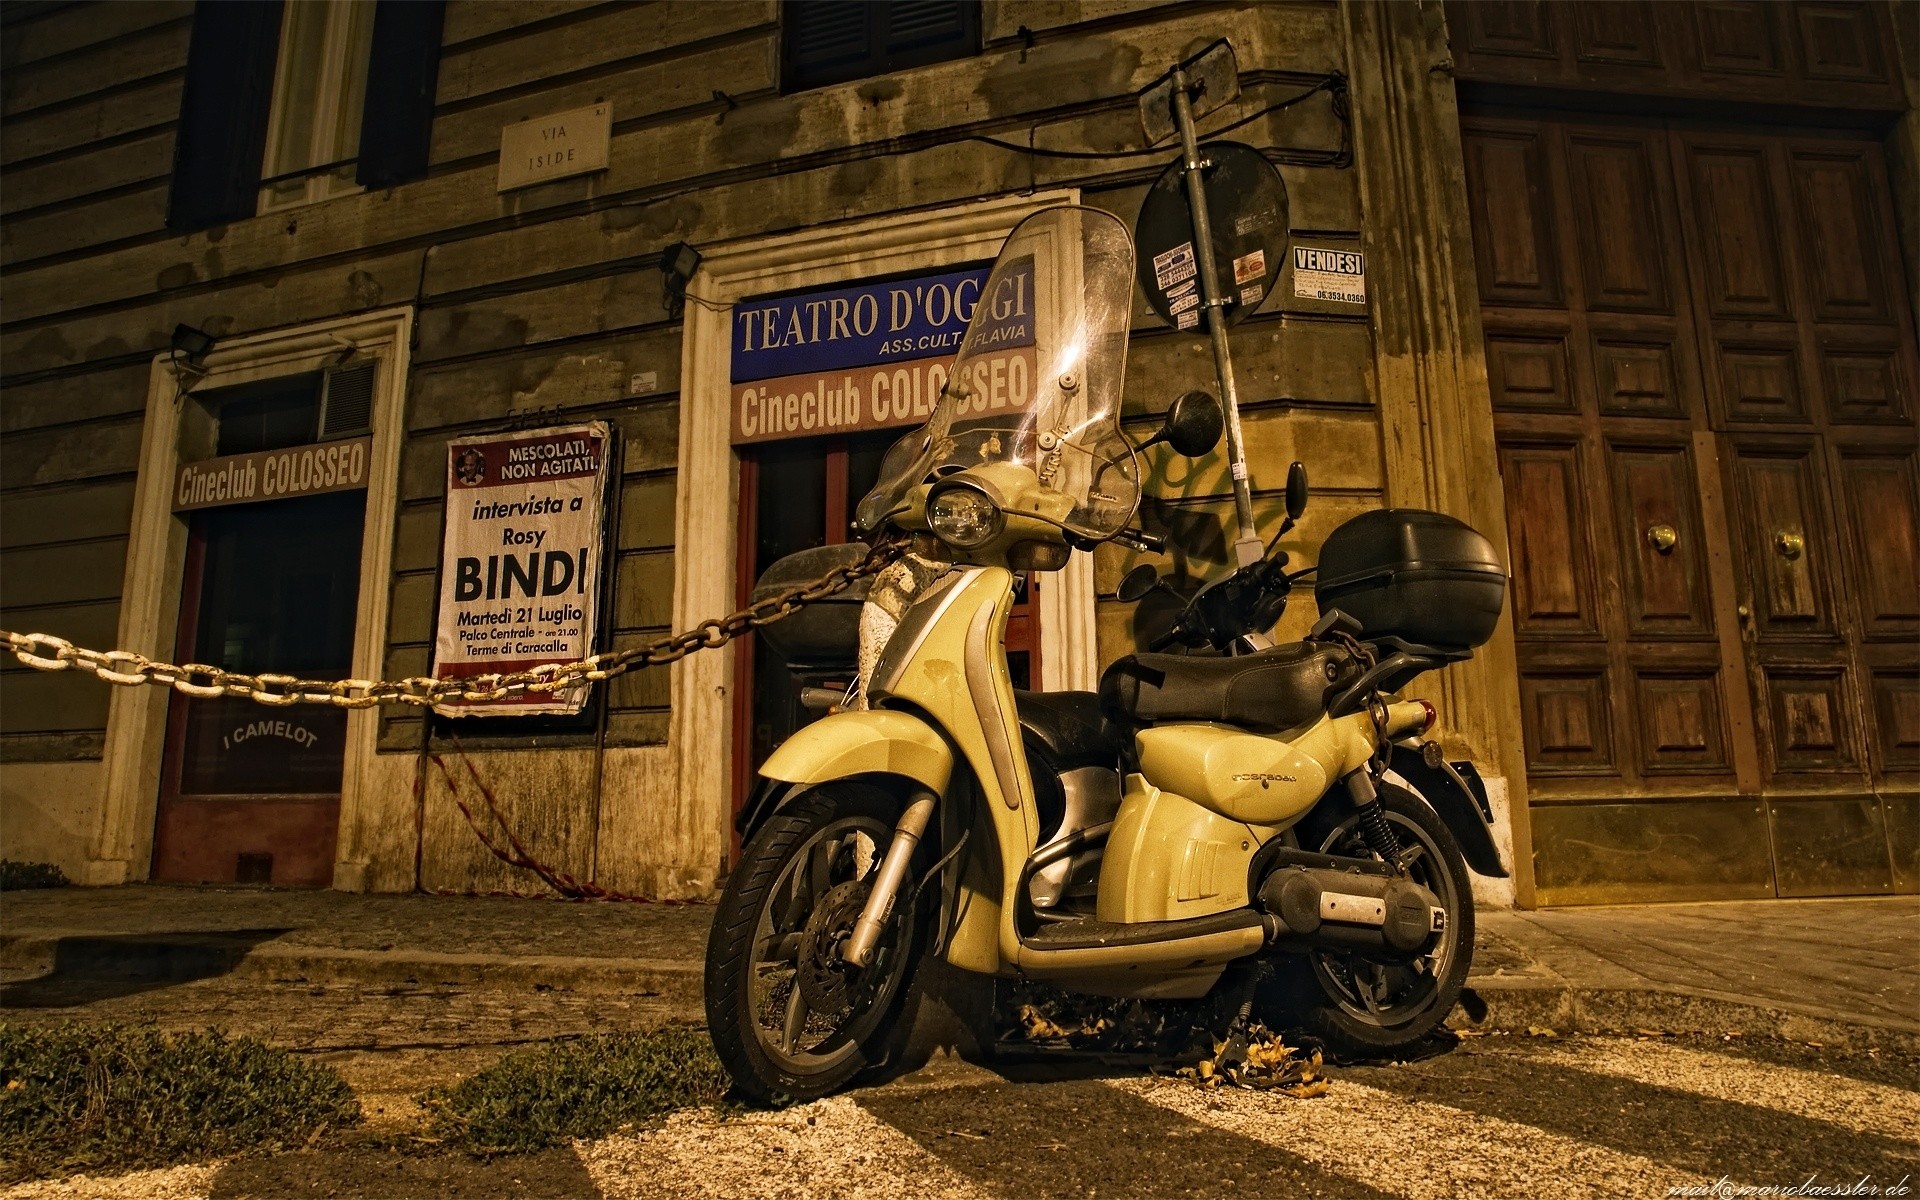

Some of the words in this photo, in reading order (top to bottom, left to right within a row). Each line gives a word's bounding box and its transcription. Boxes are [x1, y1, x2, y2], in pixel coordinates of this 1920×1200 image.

[542, 126, 566, 140] VIA
[528, 148, 575, 170] ISIDE
[1297, 249, 1361, 274] VENDESI
[738, 293, 879, 352] TEATRO
[889, 273, 1027, 332] D'OGGI
[740, 378, 860, 438] Cineclub
[871, 355, 1028, 422] COLOSSEO
[508, 440, 590, 463] MESCOLATI,
[178, 458, 257, 506] Cineclub
[262, 442, 364, 496] COLOSSEO
[501, 463, 536, 480] NON
[540, 456, 599, 476] AGITATI.
[472, 495, 563, 520] intervista
[570, 497, 583, 511] a
[503, 528, 546, 548] Rosy
[455, 548, 588, 602] BINDI
[457, 607, 512, 627] Martedì
[516, 607, 533, 623] 21
[539, 604, 583, 625] Luglio
[459, 629, 488, 641] Palco
[490, 626, 535, 640] Centrale
[557, 628, 578, 637] 21.00
[466, 644, 498, 656] Terme
[501, 642, 512, 654] di
[515, 640, 568, 654] Caracalla
[223, 735, 230, 750] I
[233, 720, 318, 749] CAMELOT
